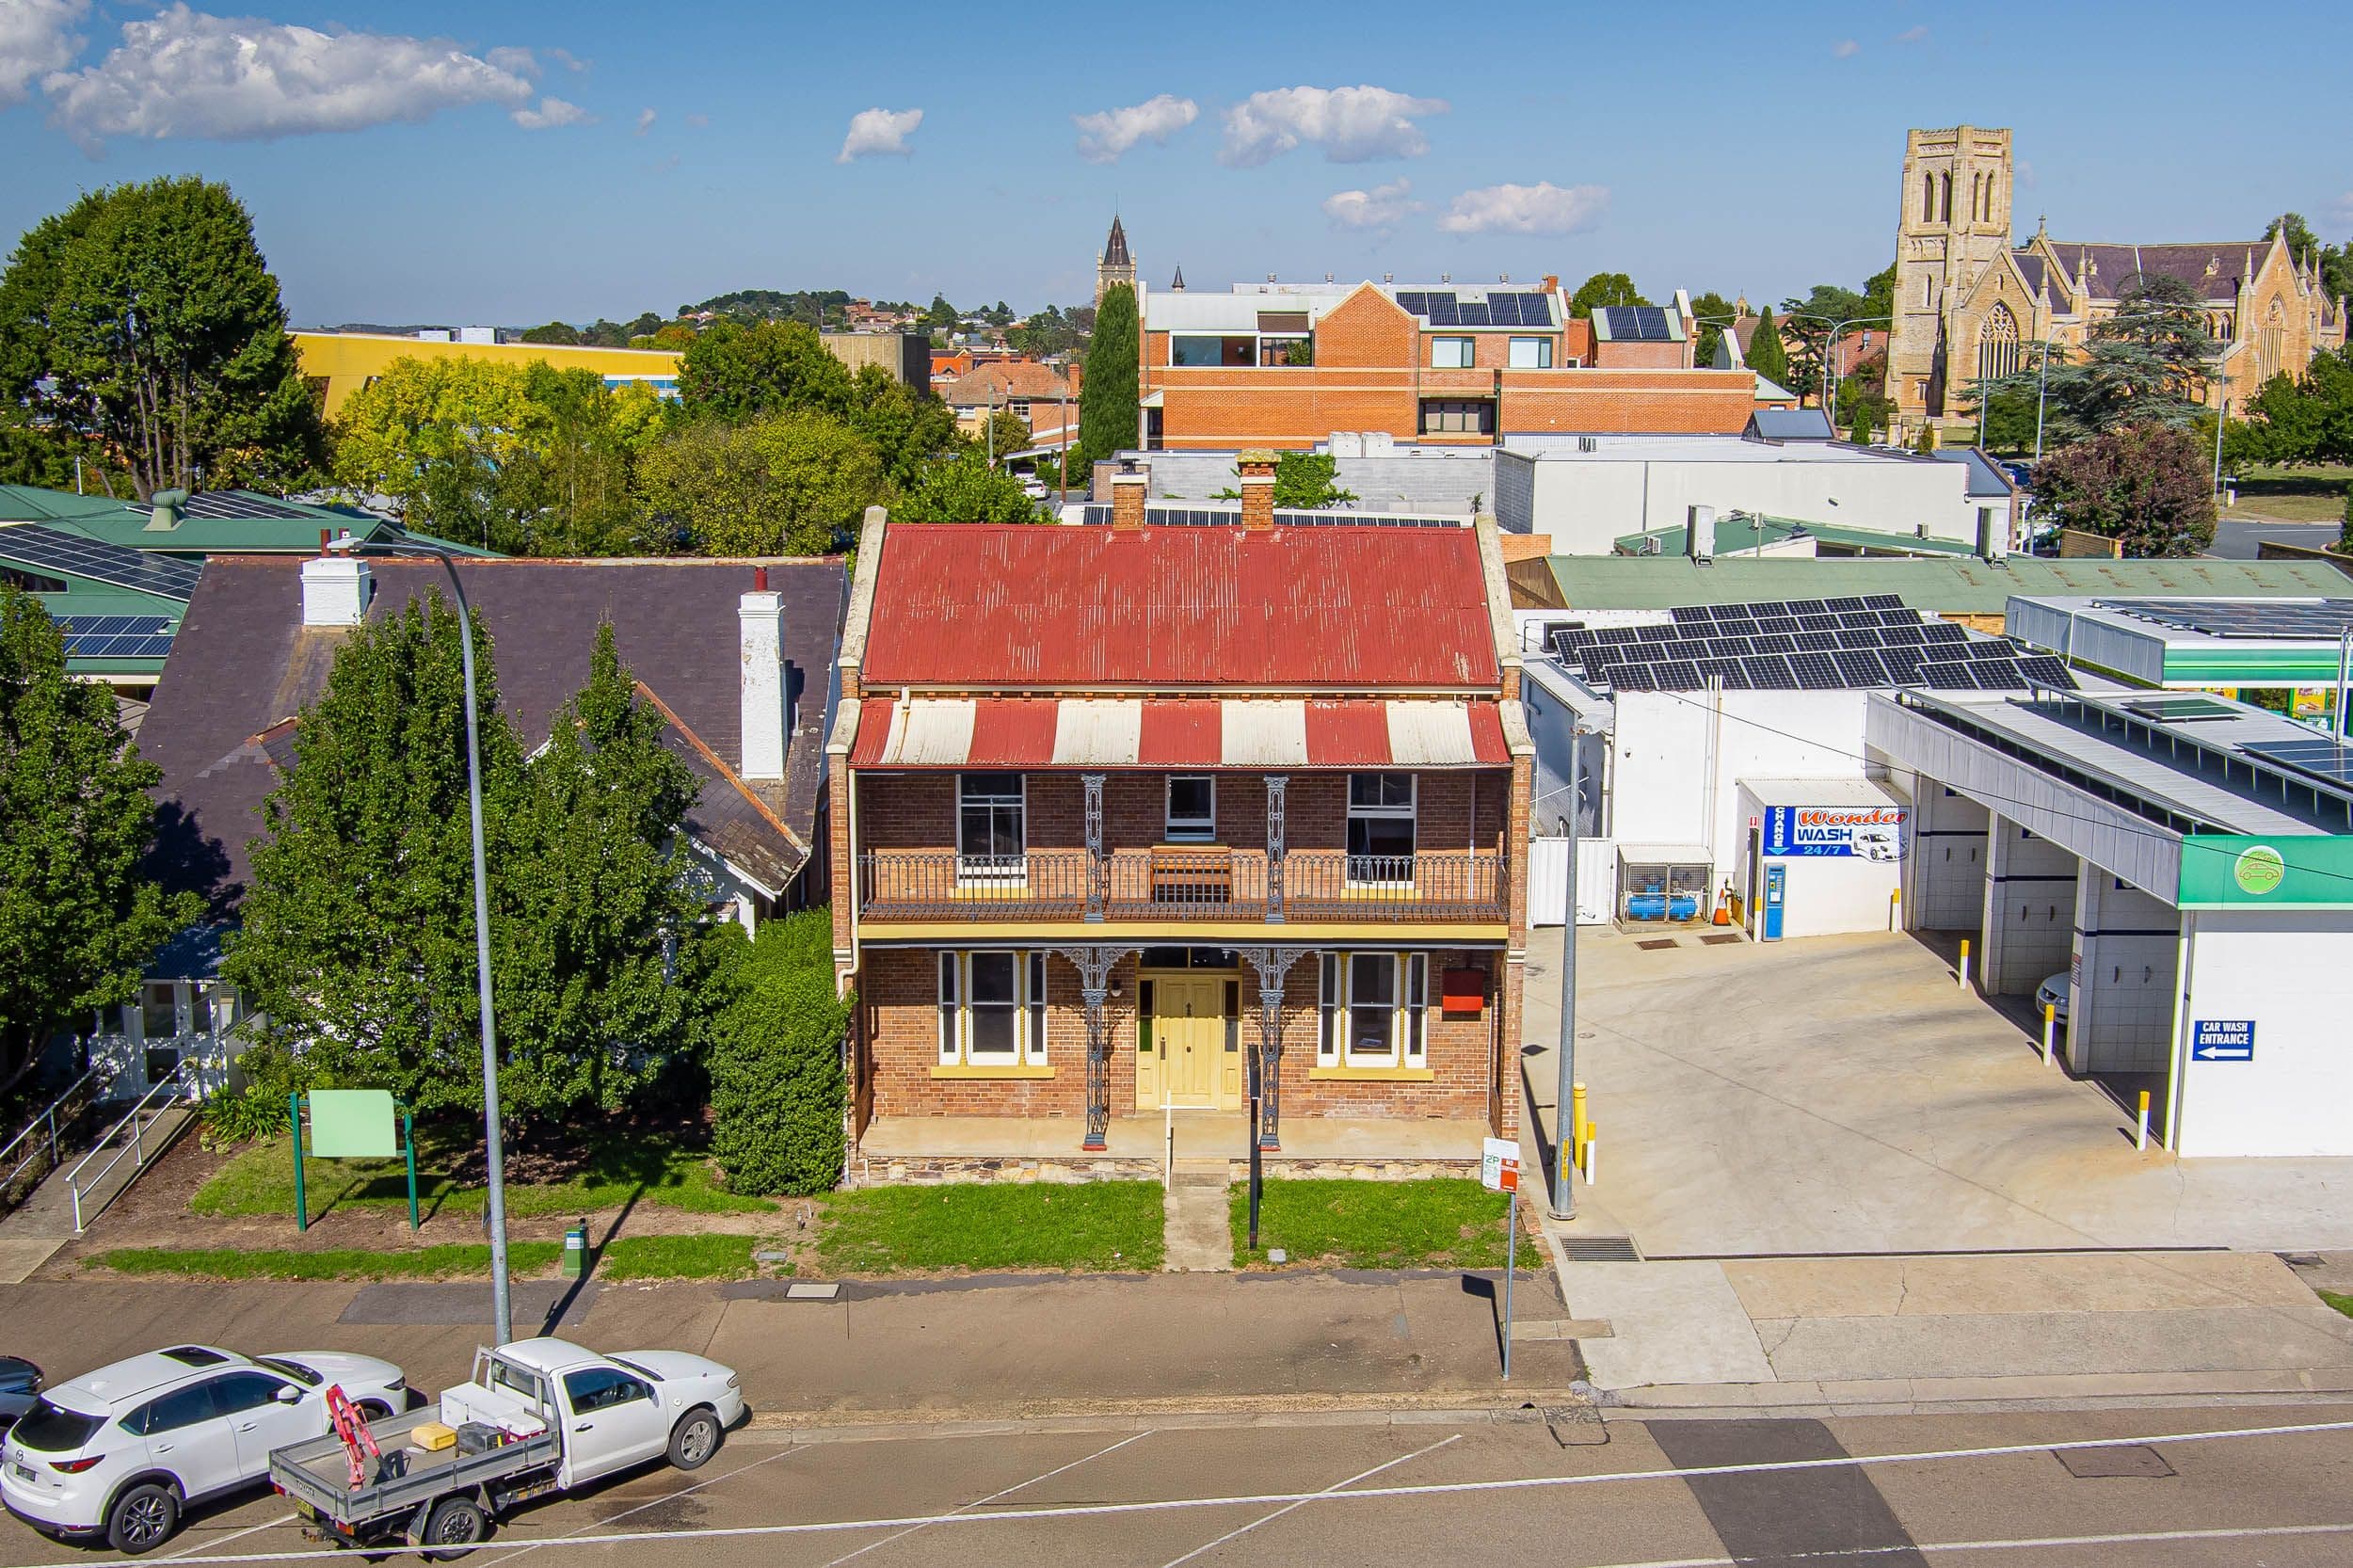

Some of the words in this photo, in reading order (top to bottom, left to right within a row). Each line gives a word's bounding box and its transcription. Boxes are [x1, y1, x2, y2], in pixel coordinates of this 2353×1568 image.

[1799, 808, 1907, 826] Wonder
[1774, 807, 1785, 847] CHANGE
[1798, 829, 1852, 840] WASH
[1803, 845, 1841, 855] 24/7
[2202, 1022, 2220, 1032] CAR
[2222, 1022, 2248, 1032] WASH
[2199, 1033, 2249, 1045] ENTRANCE
[1485, 1154, 1499, 1164] 2P
